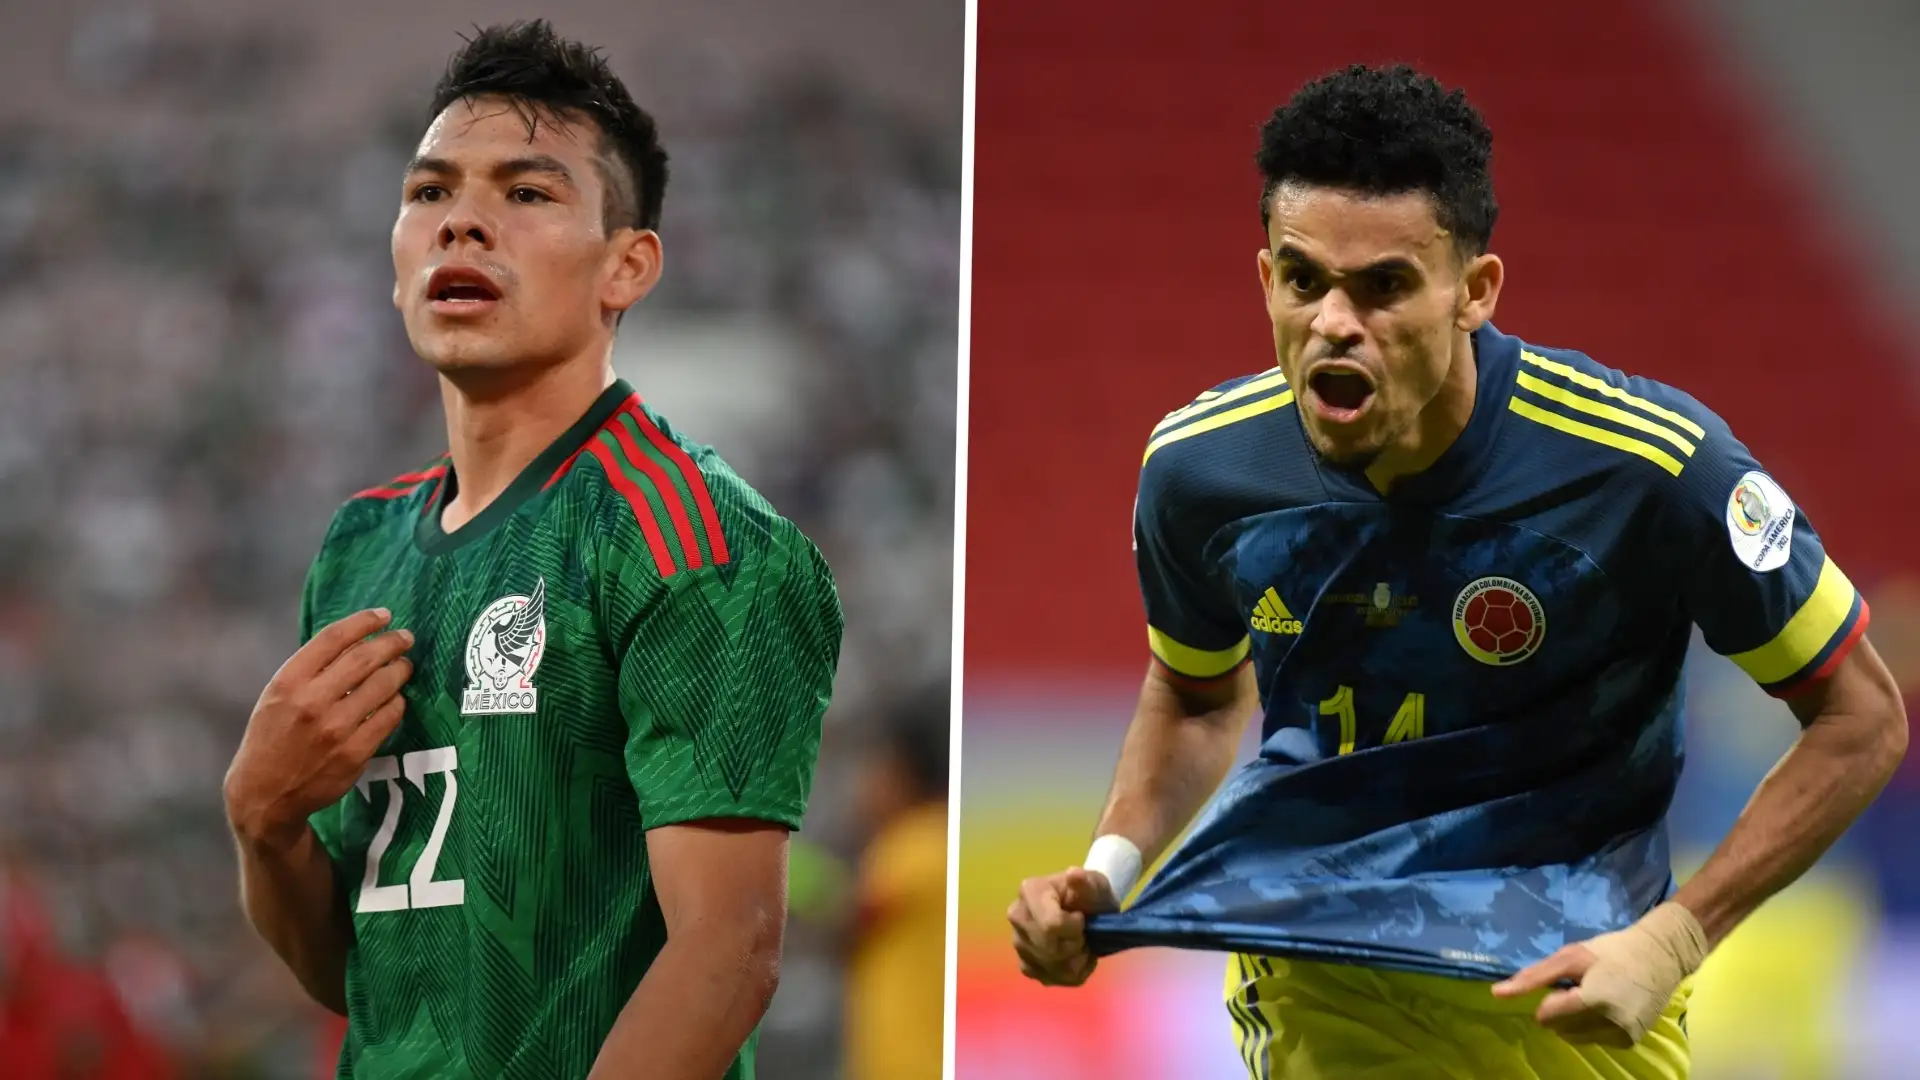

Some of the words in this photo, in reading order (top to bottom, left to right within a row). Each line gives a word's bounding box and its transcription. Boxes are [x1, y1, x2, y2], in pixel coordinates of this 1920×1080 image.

[1753, 544, 1771, 568] COPA
[1769, 508, 1794, 546] AMERICA
[1456, 585, 1481, 620] FEDERACION
[1479, 579, 1524, 596] COLOMBIANA
[1522, 592, 1533, 603] DE
[1250, 615, 1303, 635] adidas
[464, 687, 535, 712] MÉXICO
[1319, 684, 1425, 756] 14
[354, 745, 465, 913] 22
